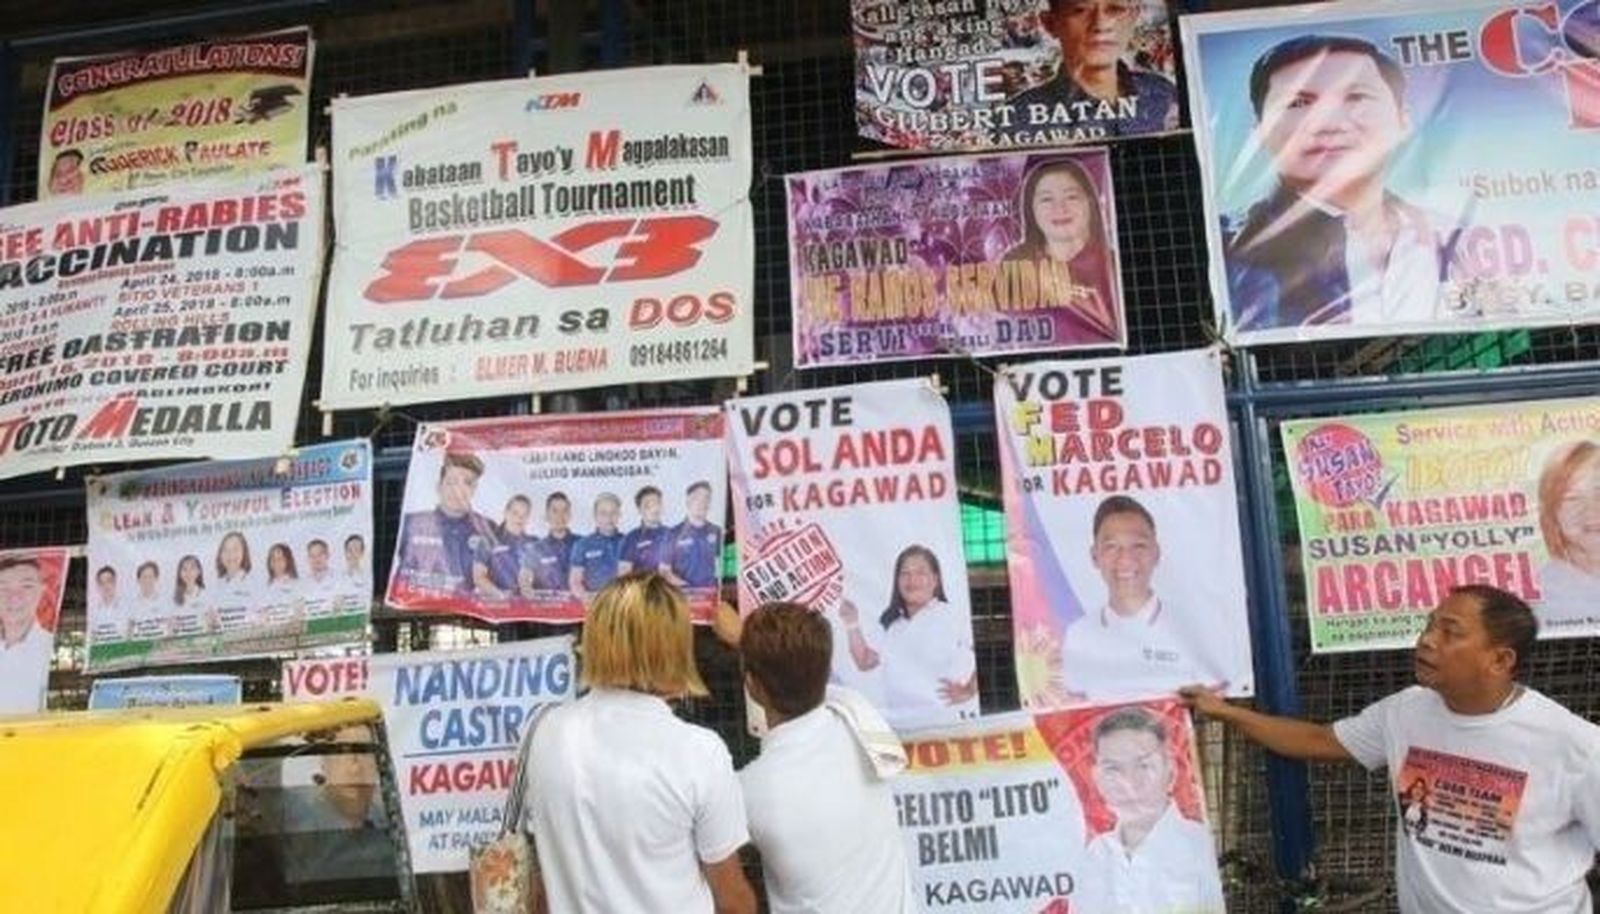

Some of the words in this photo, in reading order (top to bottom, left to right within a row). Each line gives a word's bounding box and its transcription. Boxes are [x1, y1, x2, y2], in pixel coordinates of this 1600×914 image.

[1393, 31, 1471, 64] THE
[865, 58, 1006, 108] VOTE
[50, 113, 114, 147] Class
[163, 96, 233, 129] 2018
[875, 104, 1016, 133] GILBERT
[1029, 95, 1138, 125] BATAN
[408, 185, 535, 231] Basketball
[541, 174, 697, 216] Tournament
[350, 312, 540, 354] Tatluhan
[557, 307, 610, 335] sa
[628, 291, 738, 332] DOS
[996, 316, 1052, 343] DAD
[349, 367, 374, 392] For
[377, 362, 440, 389] inquiries
[553, 347, 608, 376] BUENA
[1009, 366, 1124, 402] VOTE
[76, 399, 273, 440] MEDALLA
[741, 396, 853, 437] VOTE
[753, 437, 822, 480] SOL
[831, 425, 946, 470] ANDA
[1026, 422, 1223, 467] MARCELO
[782, 471, 947, 513] KAGAWAD
[1052, 458, 1222, 497] KAGAWAD
[1387, 491, 1529, 528] KAGAWAD
[746, 530, 824, 589] SOLUTION
[1309, 530, 1416, 560] SUSAN
[1316, 552, 1541, 615] ARCANGEL
[287, 659, 369, 696] VOTE!
[393, 653, 570, 707] NANDING
[420, 808, 452, 828] MAY
[429, 833, 449, 850] AT
[917, 826, 999, 866] BELMI
[925, 872, 1075, 906] KAGAWAD
